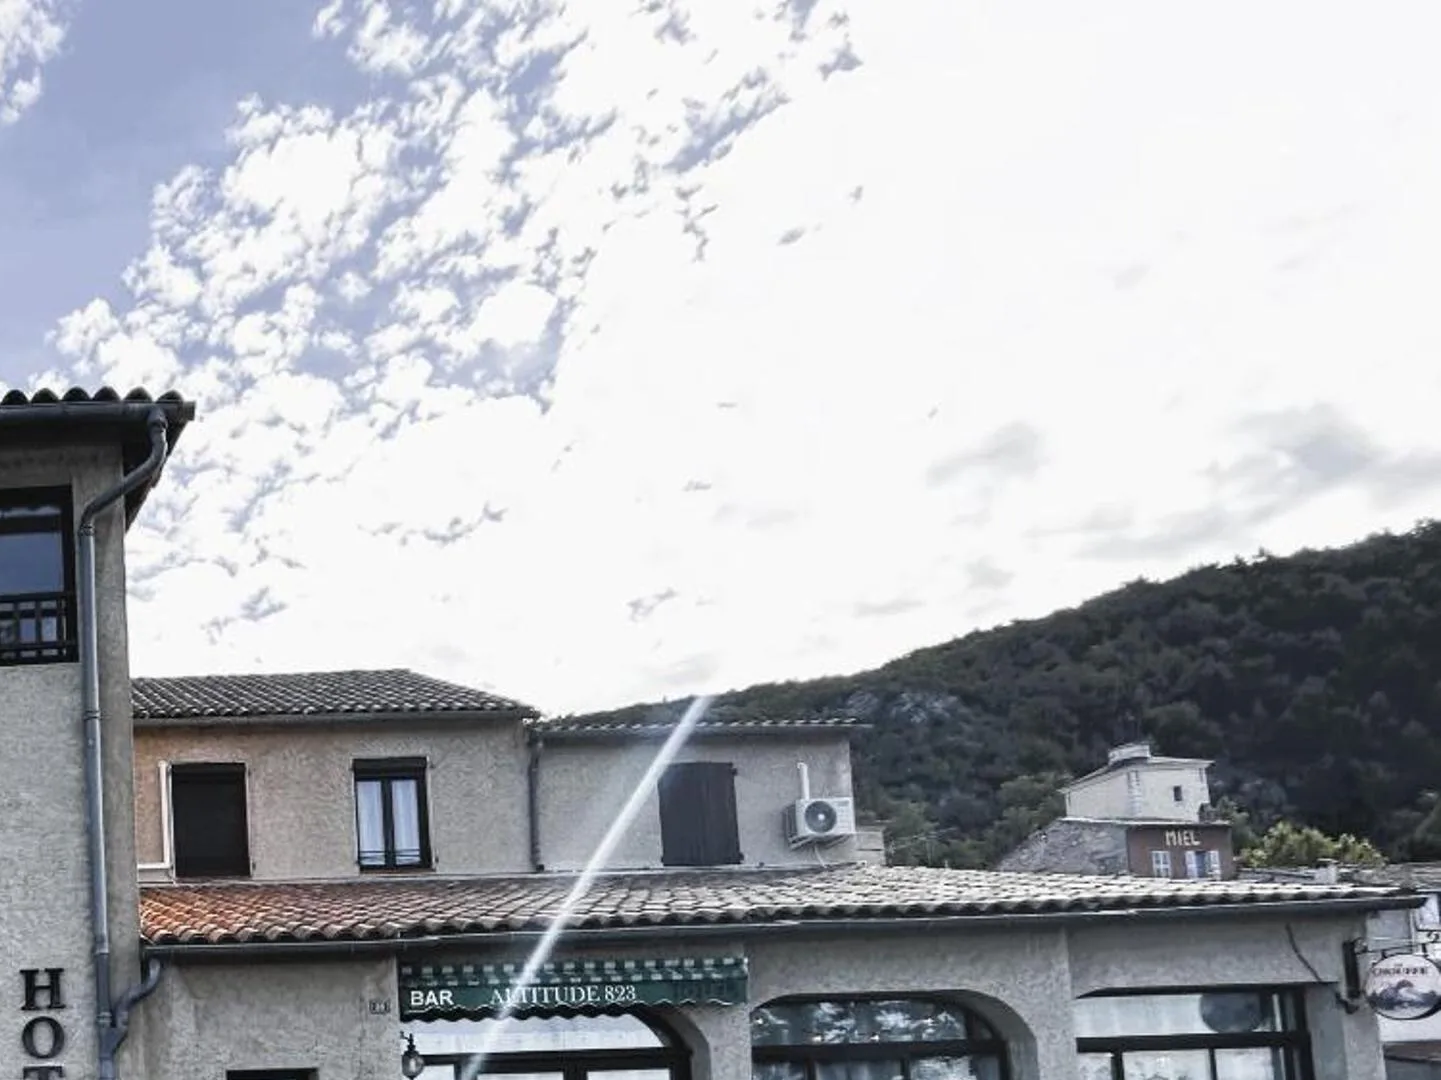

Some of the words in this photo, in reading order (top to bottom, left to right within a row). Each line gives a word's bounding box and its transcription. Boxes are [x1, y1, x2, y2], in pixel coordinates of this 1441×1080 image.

[1164, 830, 1201, 846] MIEL
[410, 990, 454, 1006] BAR
[489, 984, 601, 1005] ALTITUDE
[604, 984, 637, 1002] 823
